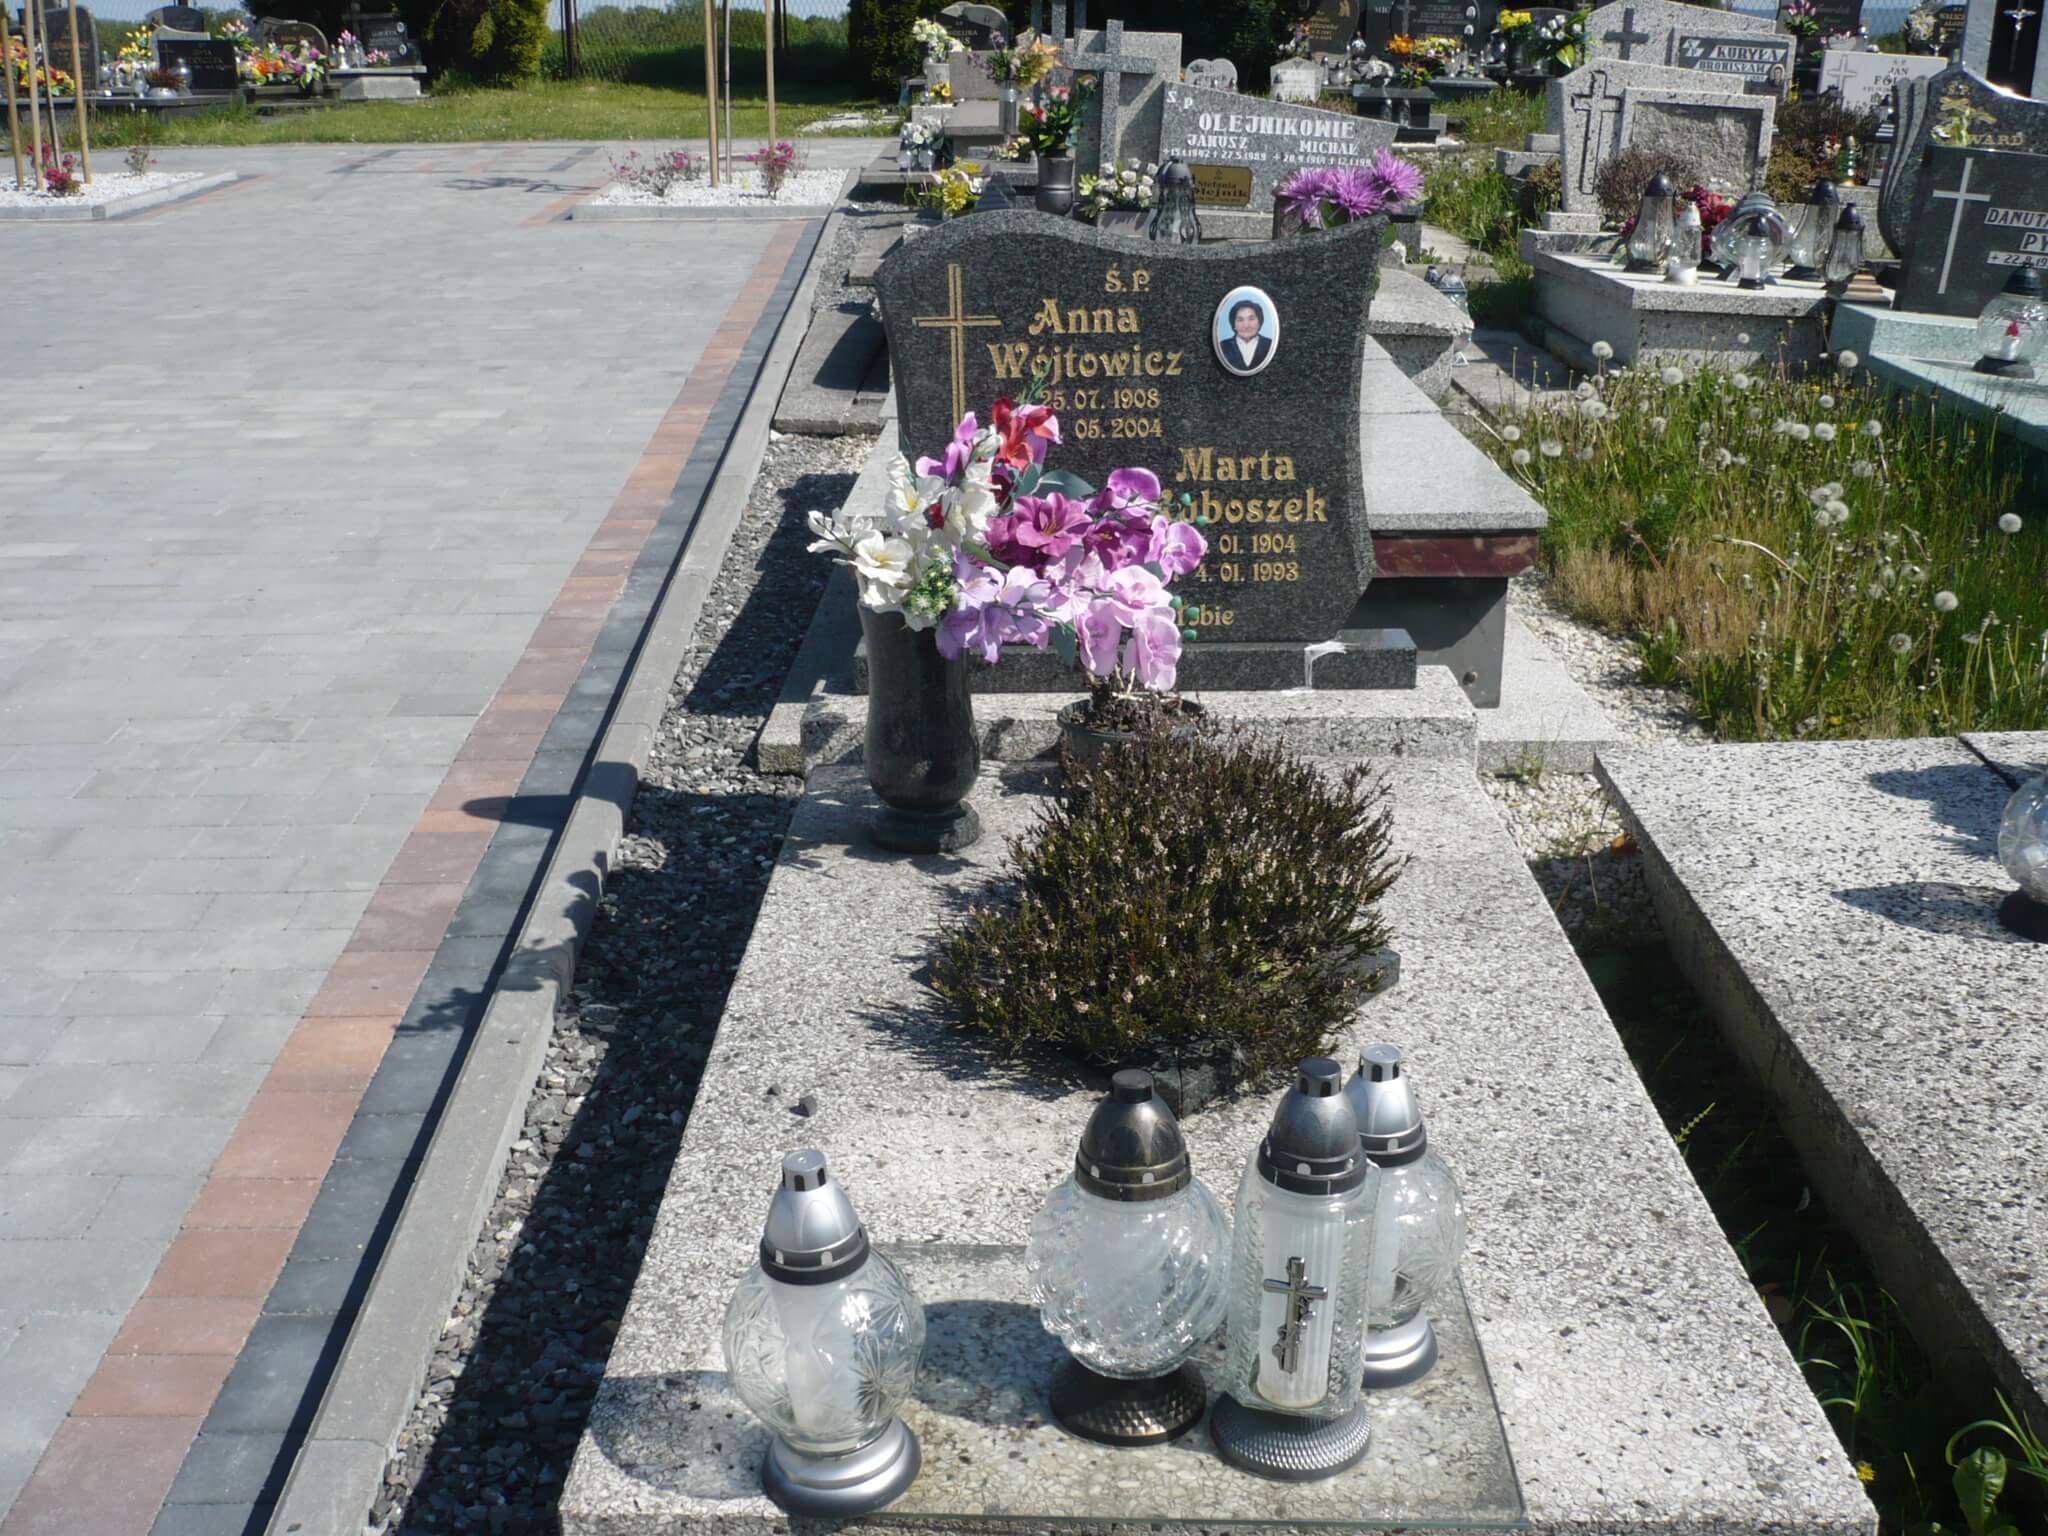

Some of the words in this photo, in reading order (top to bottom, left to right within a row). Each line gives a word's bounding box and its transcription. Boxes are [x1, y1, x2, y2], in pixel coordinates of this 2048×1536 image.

[1716, 46, 1778, 62] KURYŁA
[1198, 112, 1356, 139] OLEJNIKOWIE
[1187, 133, 1249, 150] JANUSZ
[1299, 140, 1359, 156] MICHAŁ
[1028, 298, 1140, 335] Anna
[986, 343, 1185, 385] Wójtowicz
[1113, 388, 1161, 409] 1908
[1111, 418, 1162, 439] 2004
[1175, 447, 1296, 482] Marta
[1251, 534, 1297, 554] 1904
[1253, 562, 1299, 582] 1993
